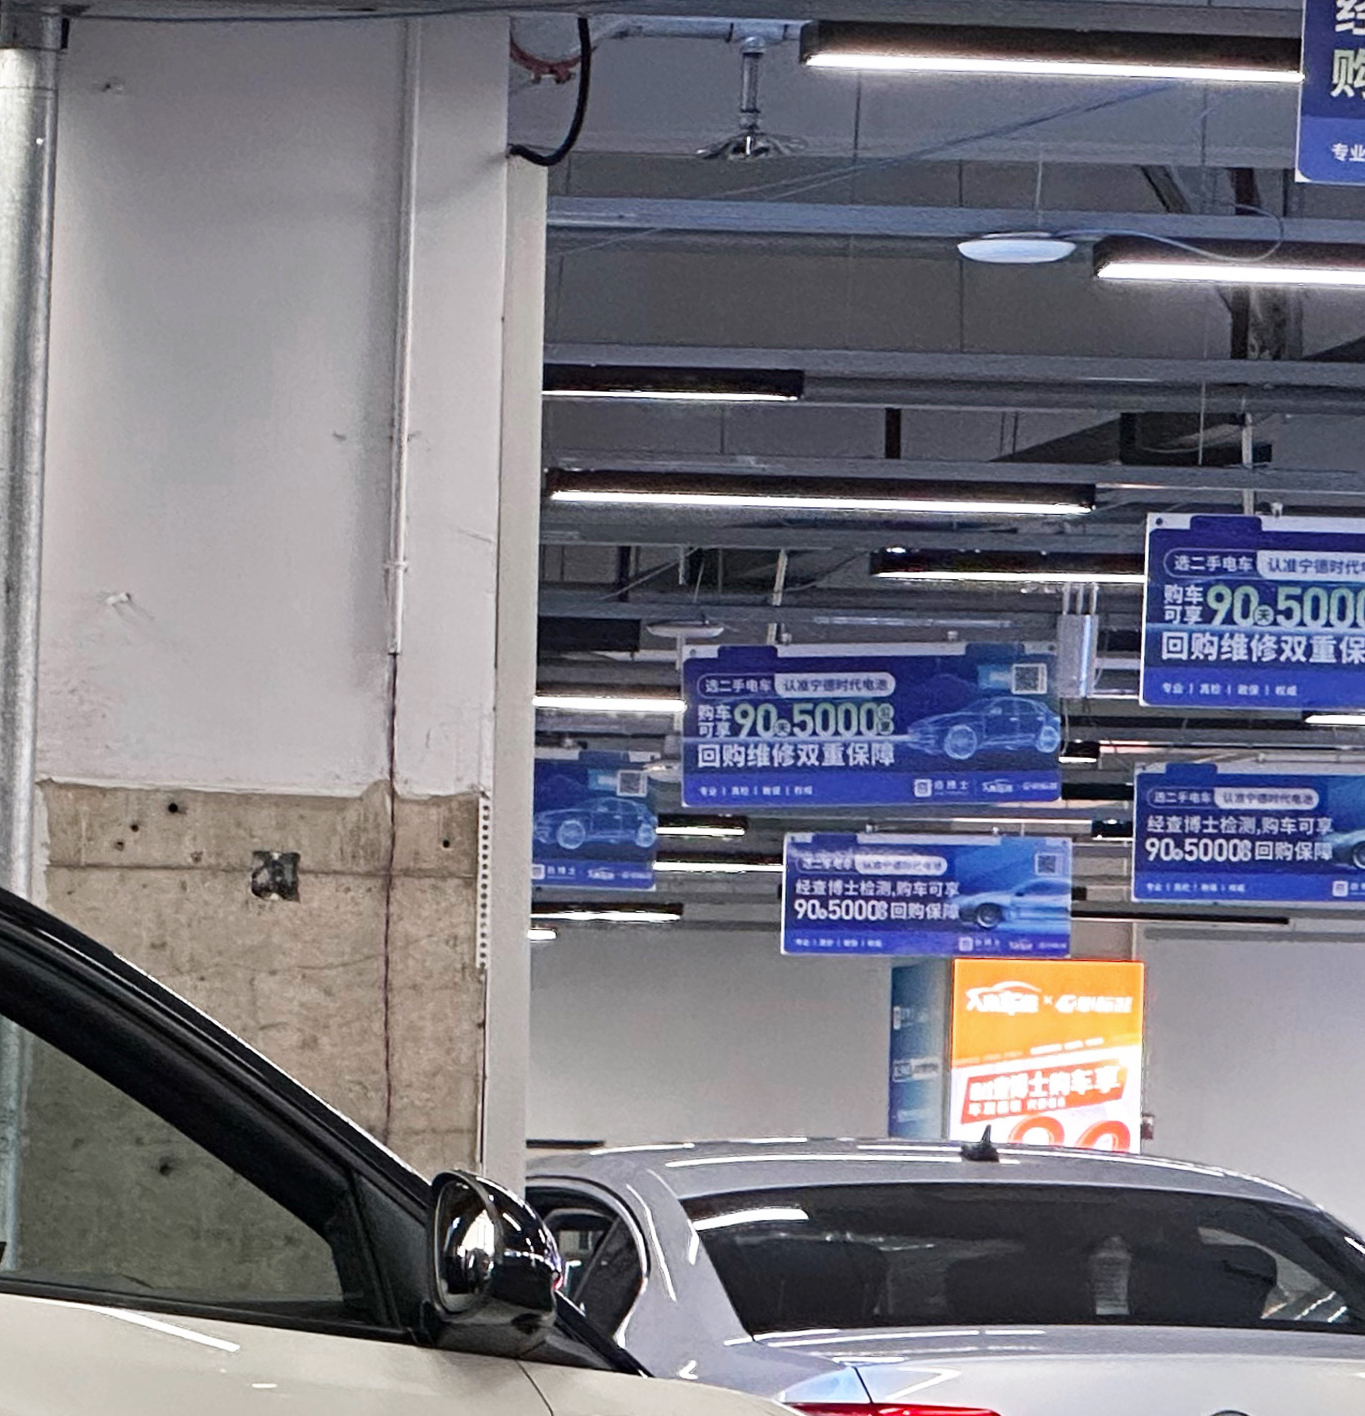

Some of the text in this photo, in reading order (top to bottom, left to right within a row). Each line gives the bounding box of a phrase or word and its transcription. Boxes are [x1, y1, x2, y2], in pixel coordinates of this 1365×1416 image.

[1174, 555, 1253, 572] 选二手电车
[1164, 584, 1203, 604] 购车
[1164, 605, 1203, 625] 可享
[1161, 631, 1365, 665] 回购维修双重保
[705, 679, 771, 693] 选二手电车
[784, 678, 888, 692] 认准宁德时代电池
[698, 704, 731, 721] 购车
[698, 722, 731, 738] 可享
[697, 743, 895, 768] 回购维修双重保障
[1146, 815, 1333, 836] 经查博士检测,购车可享
[1254, 841, 1333, 861] 回购保障
